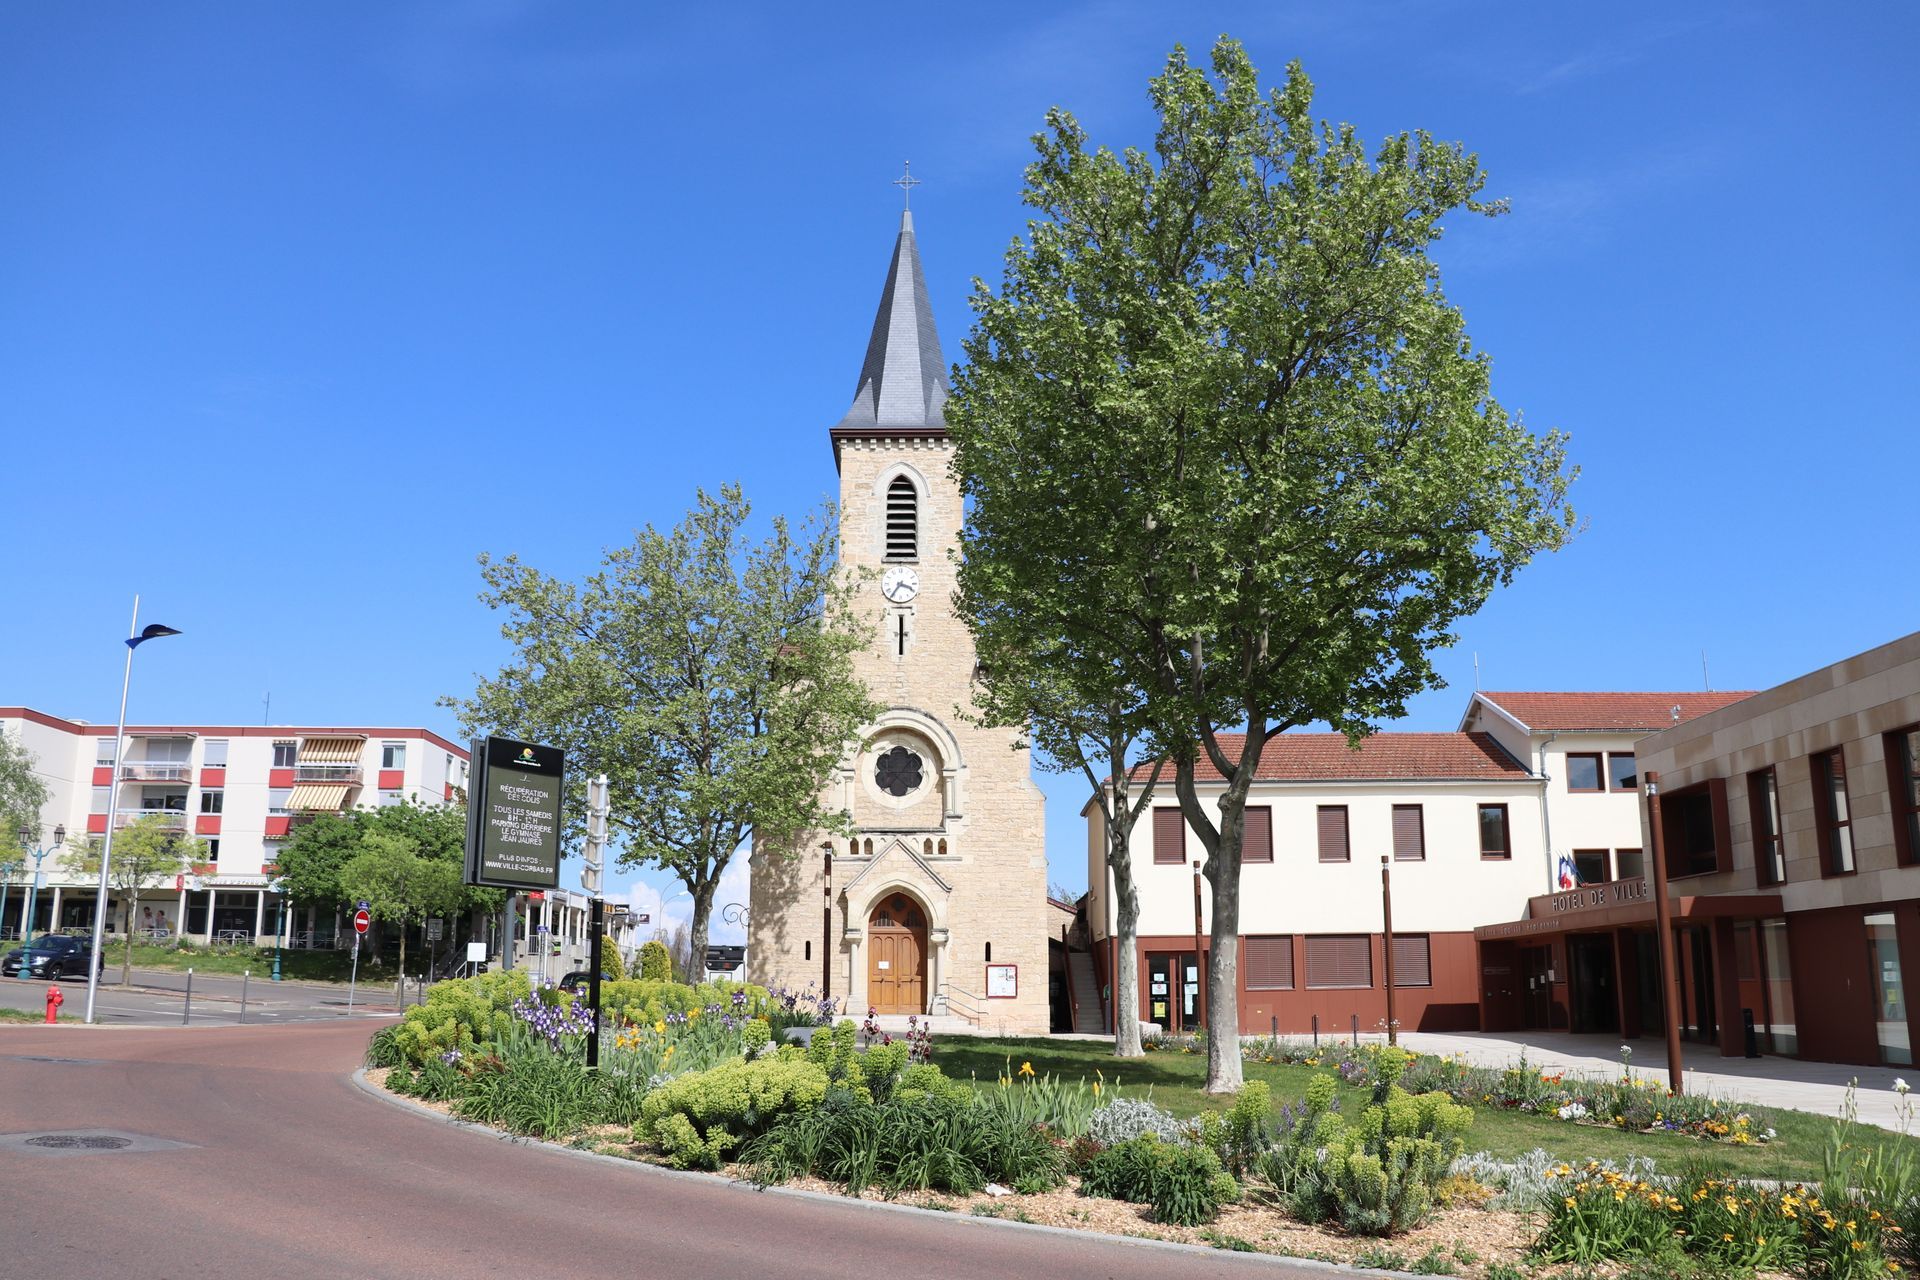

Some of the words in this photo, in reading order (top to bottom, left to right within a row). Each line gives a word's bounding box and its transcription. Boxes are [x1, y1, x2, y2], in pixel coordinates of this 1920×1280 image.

[500, 784, 549, 798] RÉCUPÉRATION
[507, 793, 520, 801] DES
[521, 795, 541, 805] COLIS
[493, 805, 512, 813] TOUS
[512, 808, 525, 816] LES
[525, 809, 553, 820] SAMEDIS
[491, 819, 520, 829] PARKING
[500, 834, 517, 843] JEAN
[501, 827, 510, 835] LE
[510, 828, 541, 839] GYMNASE
[498, 853, 515, 862] PLUS
[485, 860, 554, 874] WWW.VILLE-CORBAS.FR
[1590, 888, 1606, 905] DE
[1613, 880, 1648, 901] VILLE
